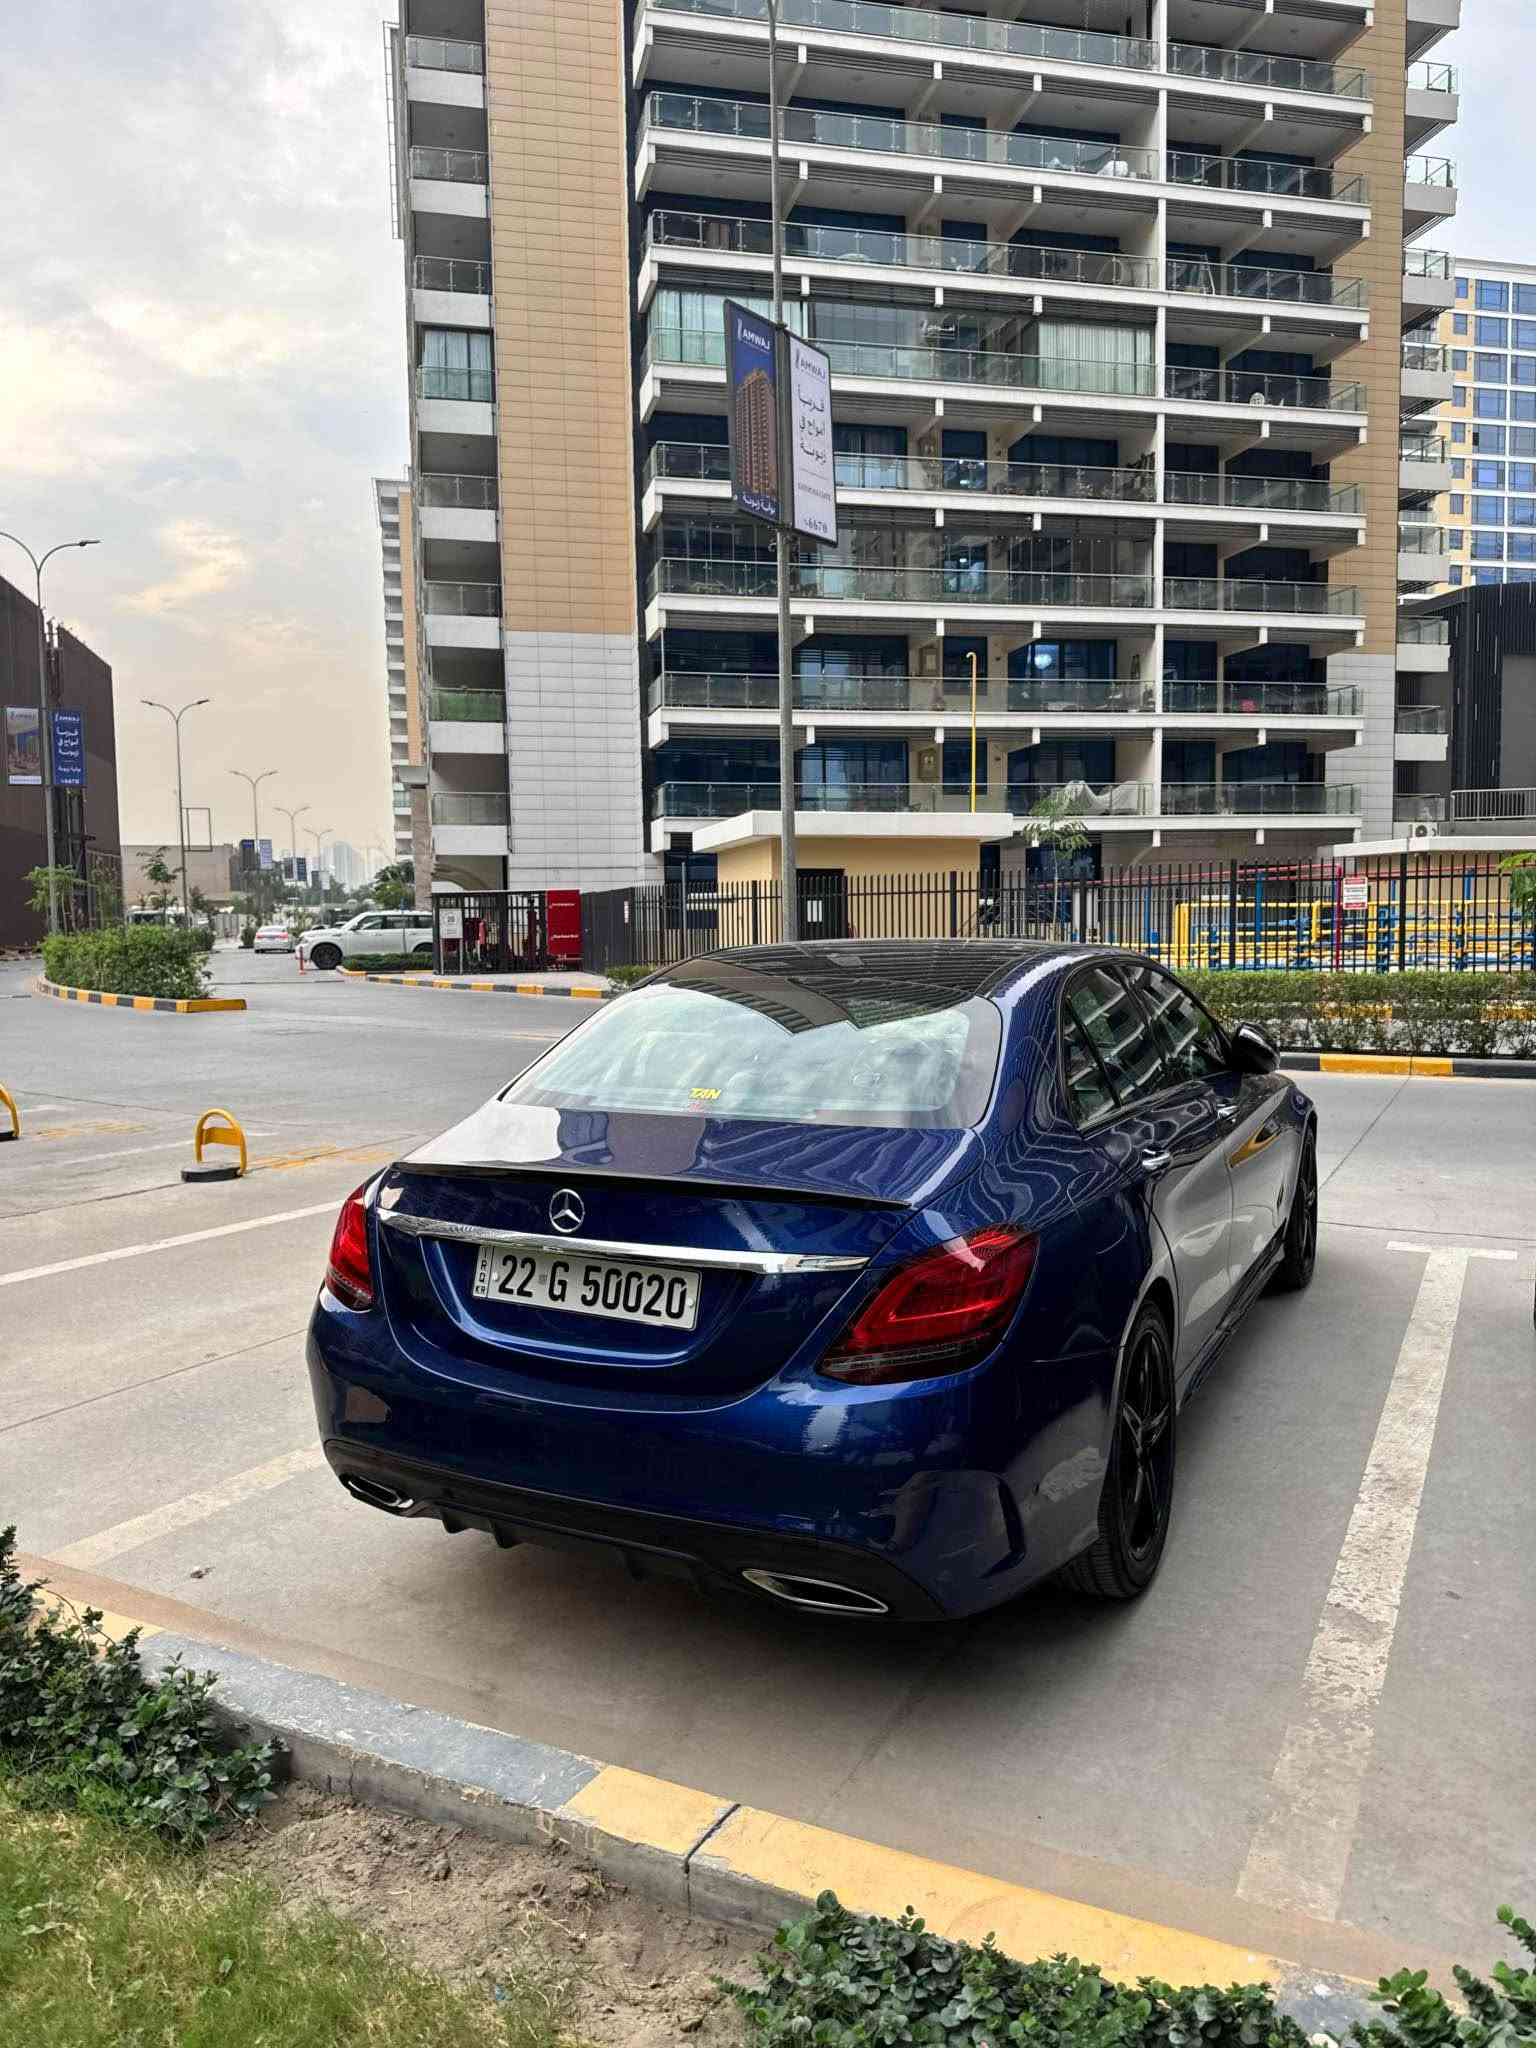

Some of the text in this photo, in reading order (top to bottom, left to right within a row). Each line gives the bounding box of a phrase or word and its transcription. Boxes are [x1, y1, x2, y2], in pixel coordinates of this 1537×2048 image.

[742, 328, 770, 350] AMWAJ
[800, 359, 826, 380] AMWAJ
[498, 1255, 688, 1320] 22 G 50020
